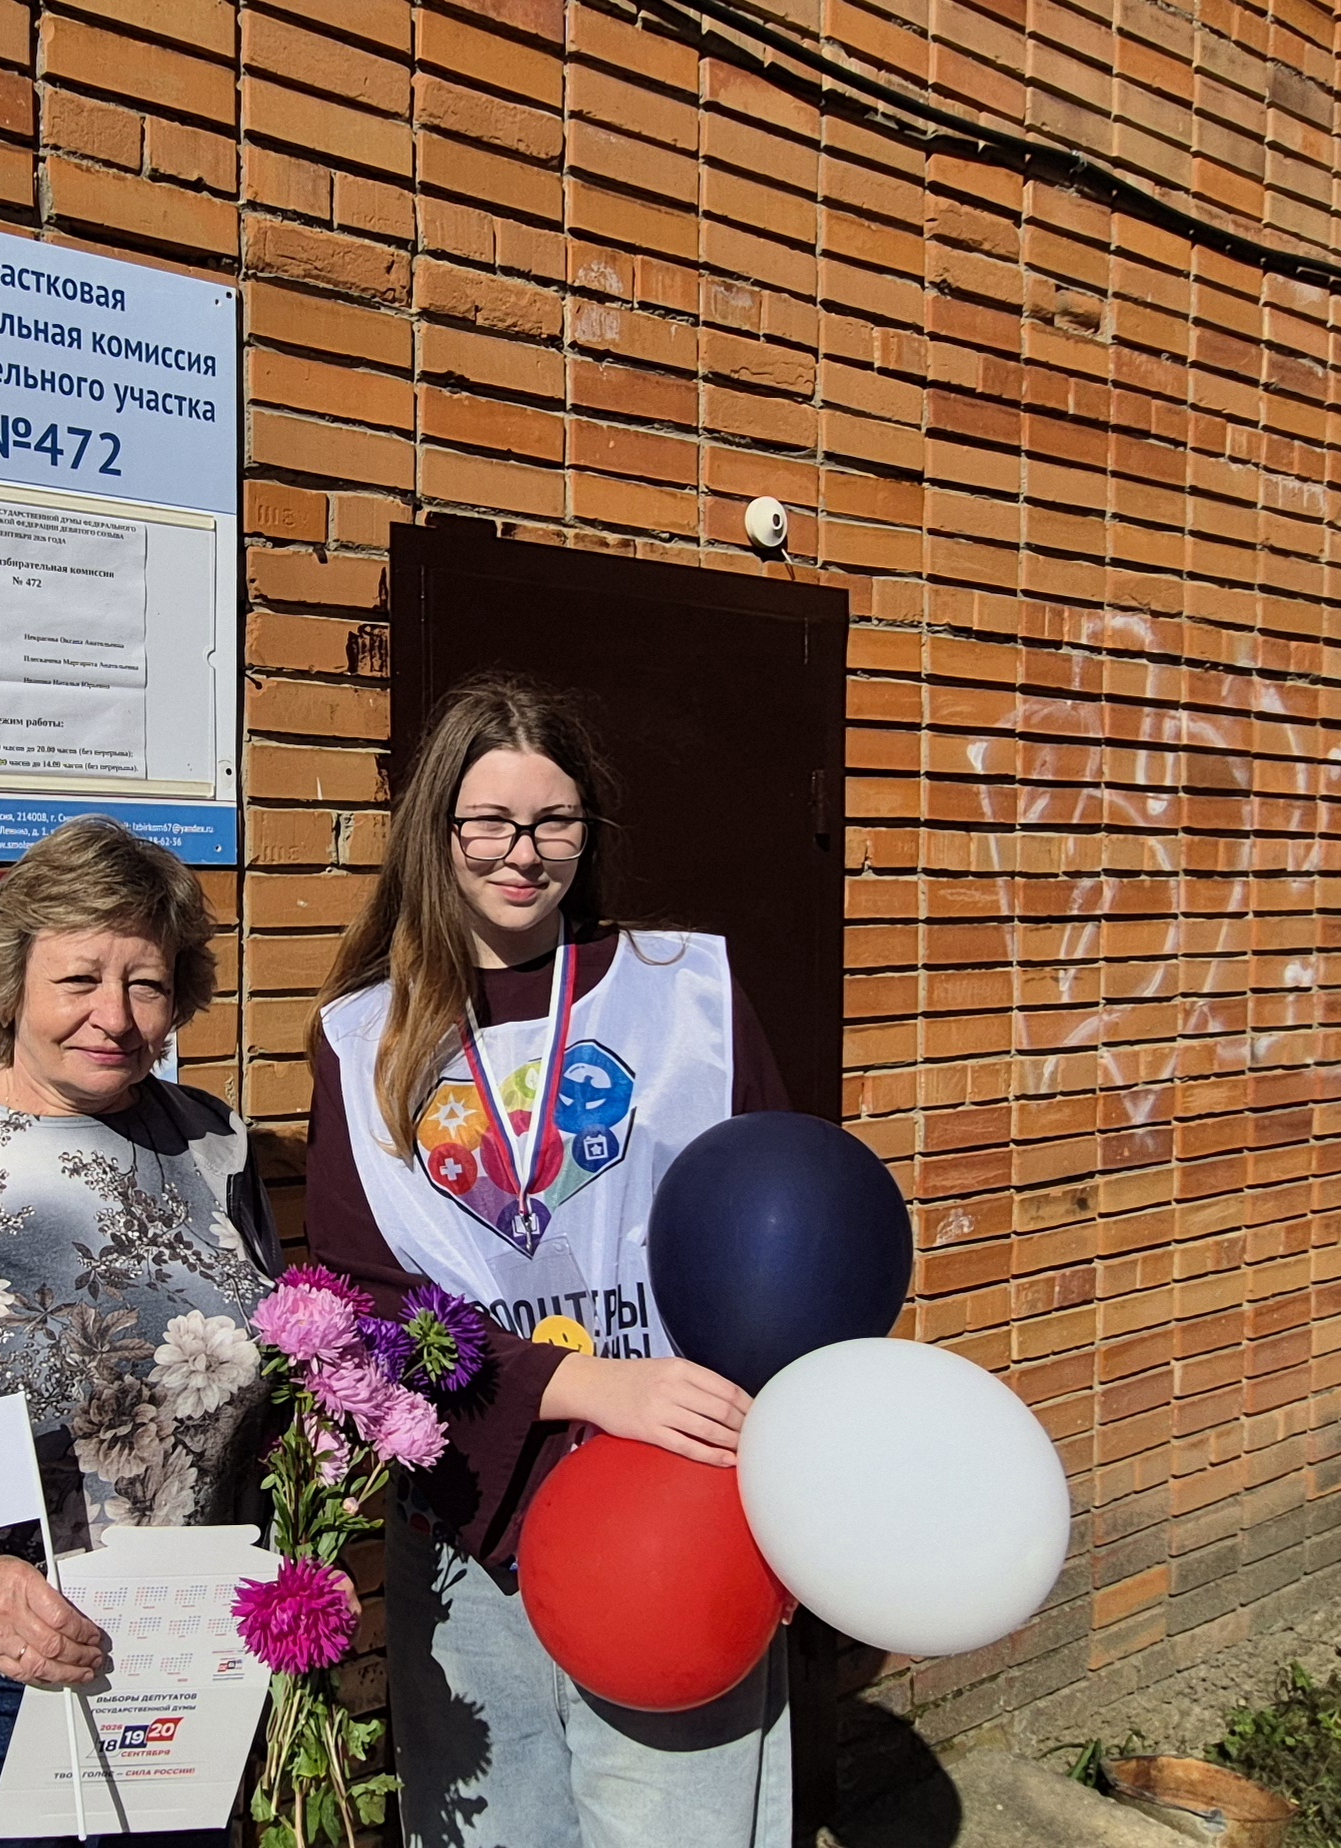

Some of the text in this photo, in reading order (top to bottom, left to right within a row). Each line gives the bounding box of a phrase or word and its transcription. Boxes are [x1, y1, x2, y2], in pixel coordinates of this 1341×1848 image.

[92, 331, 216, 376] комиссия
[114, 382, 215, 422] участка
[70, 567, 114, 578] комиссия
[26, 577, 42, 588] 472
[26, 718, 64, 728] работы:
[141, 1693, 198, 1702] ДЕПУТАТОВ
[99, 1722, 175, 1753] 18 19 20
[121, 1749, 171, 1758] СЕНТЯБРЯ
[125, 1769, 152, 1777] СИЛА
[154, 1767, 196, 1776] РОССИИ!
